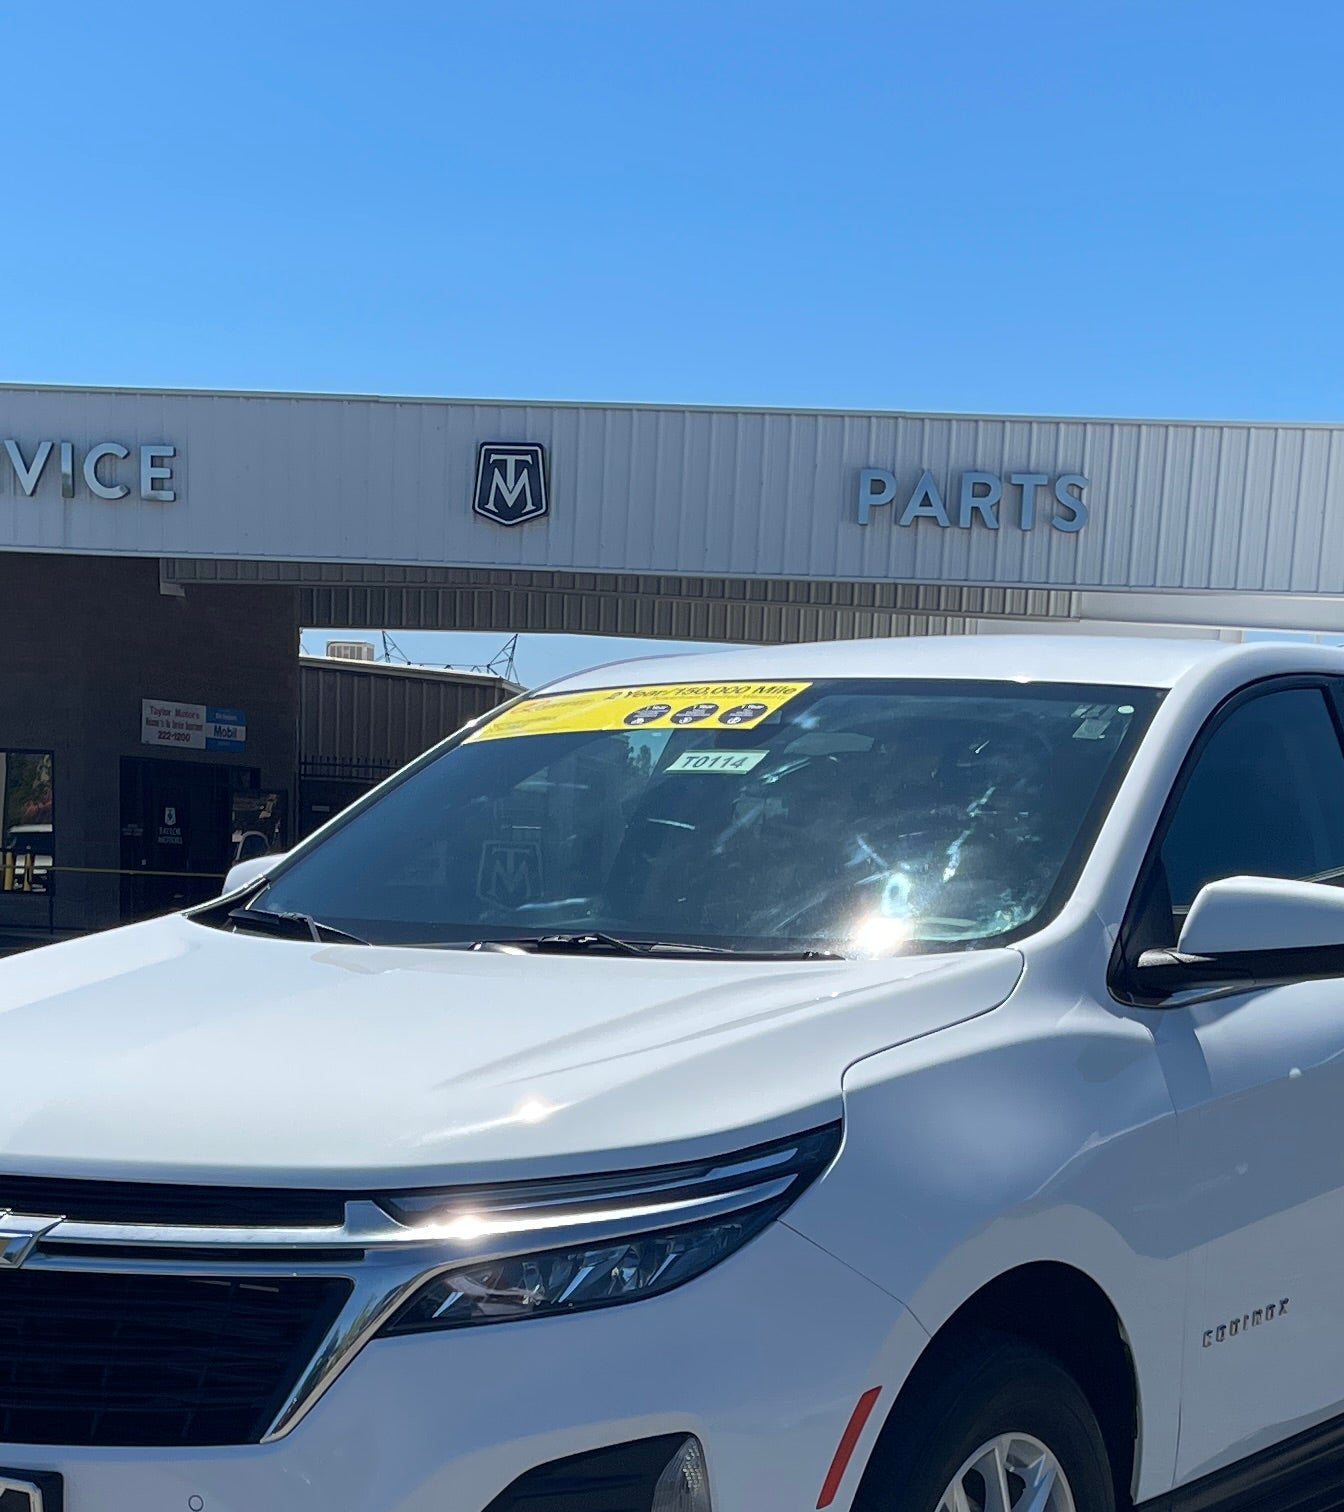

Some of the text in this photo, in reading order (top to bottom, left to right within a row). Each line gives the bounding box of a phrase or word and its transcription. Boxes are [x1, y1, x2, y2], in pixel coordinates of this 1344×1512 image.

[857, 467, 1090, 533] PARTS
[755, 685, 798, 695] Mile
[213, 725, 238, 738] Mobil
[681, 755, 749, 769] T0114
[1202, 1297, 1290, 1348] EQUINOX
